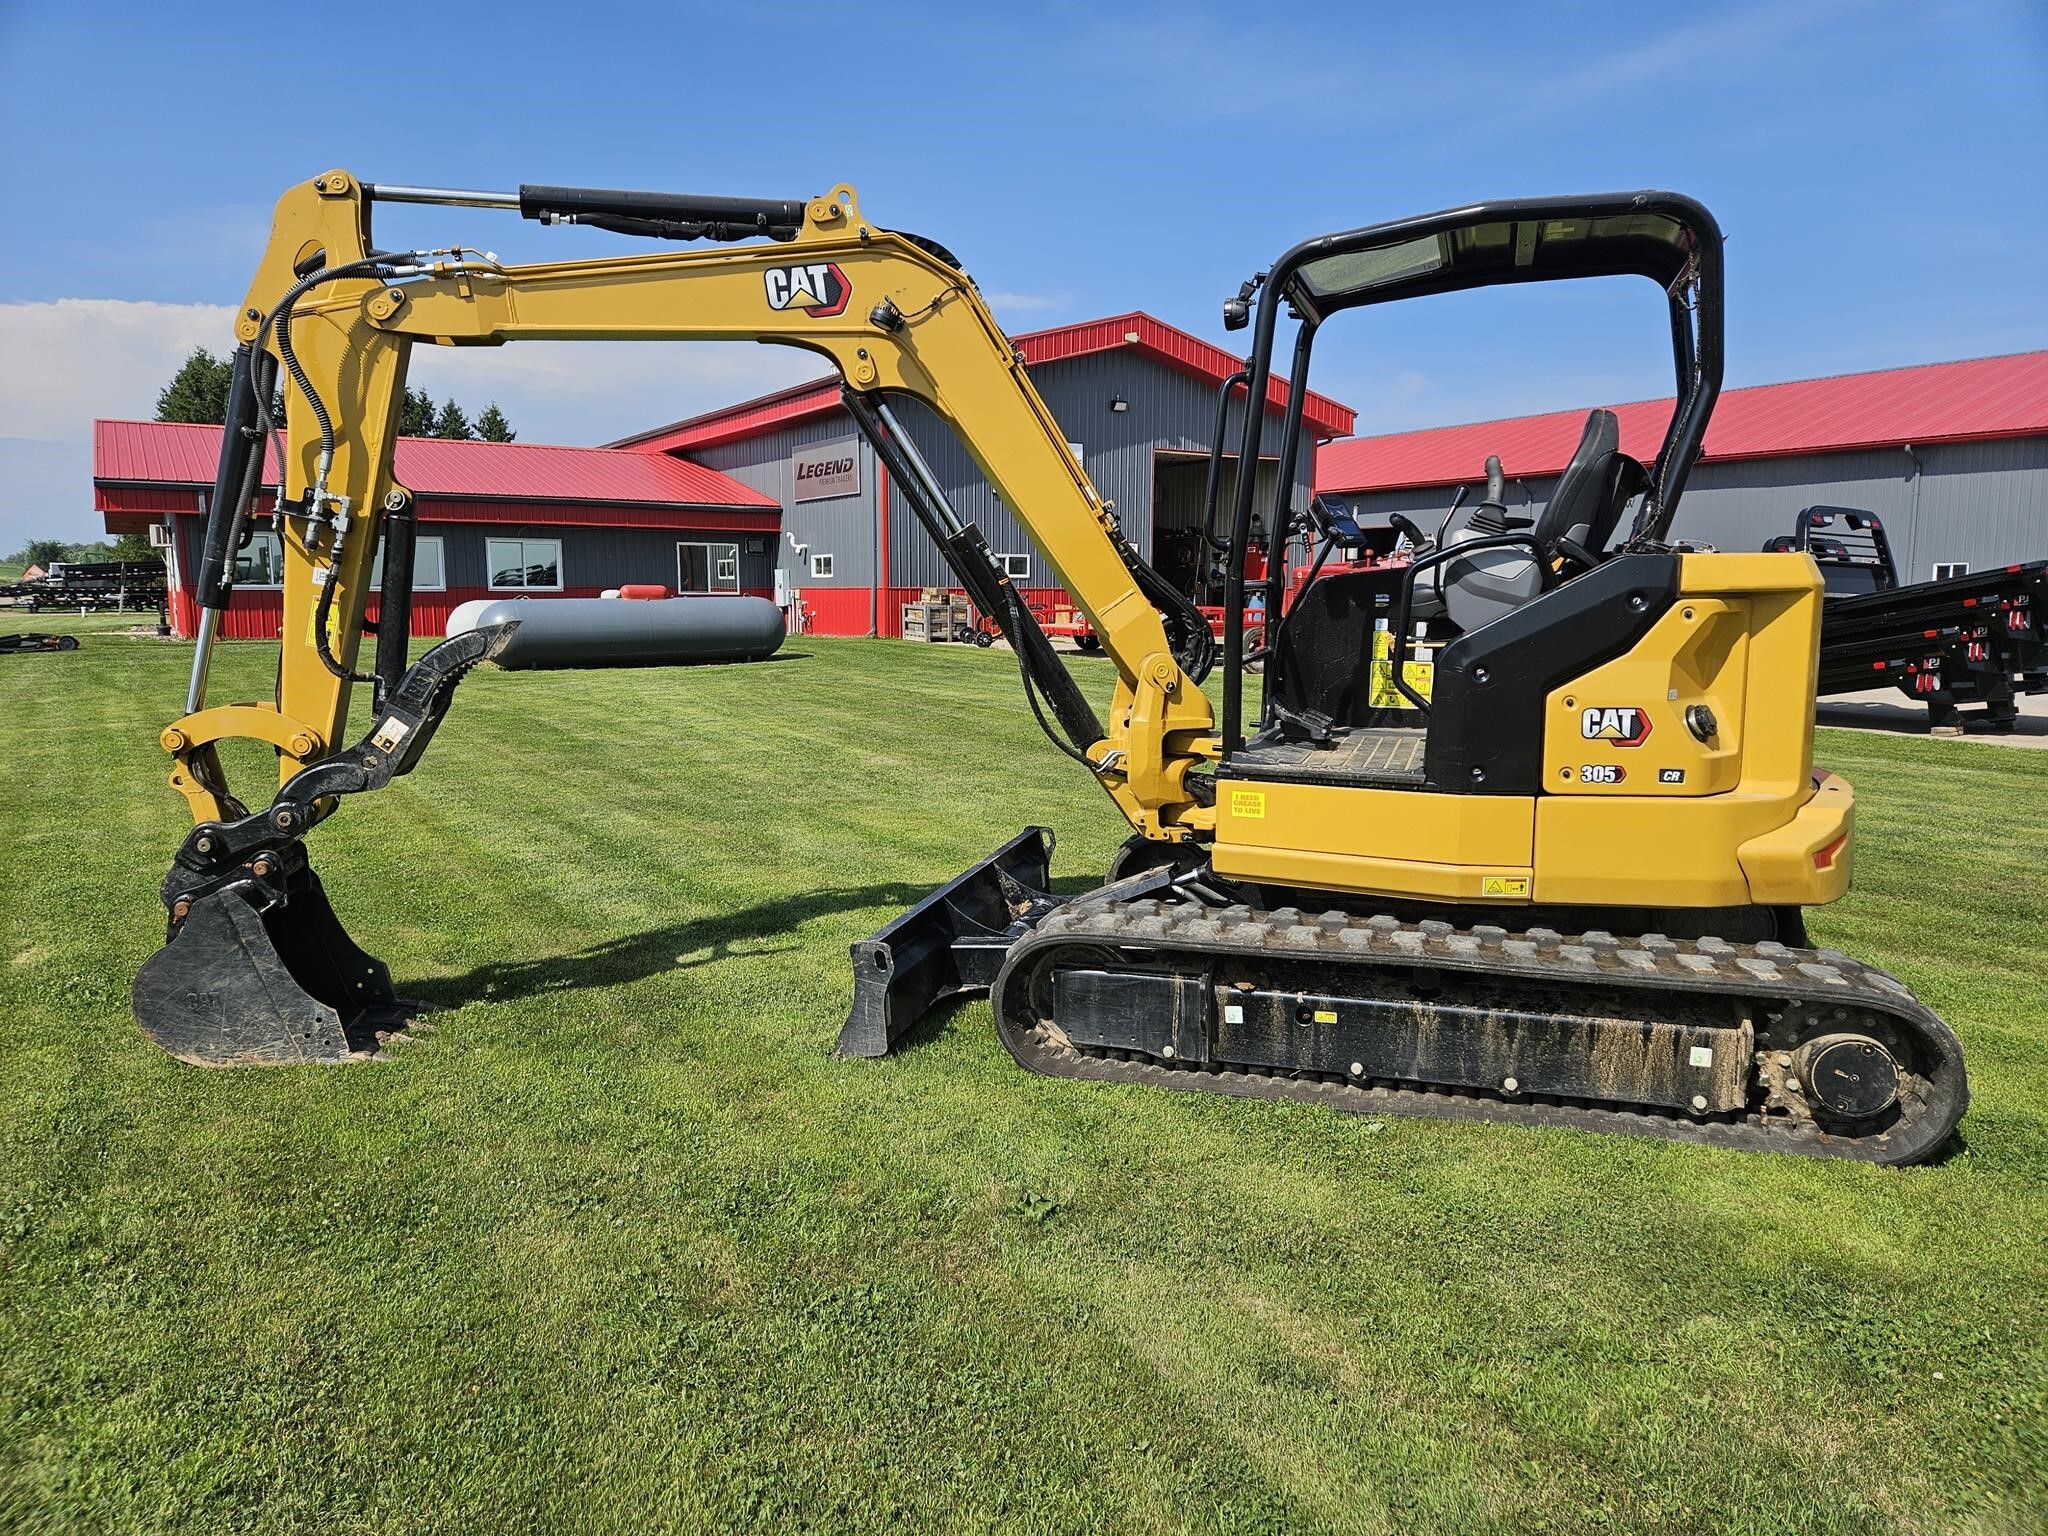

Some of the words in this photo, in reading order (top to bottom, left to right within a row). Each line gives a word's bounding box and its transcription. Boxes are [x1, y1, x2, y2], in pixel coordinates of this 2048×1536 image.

[765, 264, 829, 310] CAT
[797, 458, 854, 480] LEGEND
[1928, 657, 1940, 667] PJ
[1582, 708, 1636, 739] CAT
[1581, 766, 1616, 782] 305
[1663, 771, 1680, 781] CR
[1233, 799, 1262, 807] GREASE
[1233, 806, 1243, 814] TO
[1245, 807, 1261, 815] LIVE
[185, 991, 219, 1010] CAT
